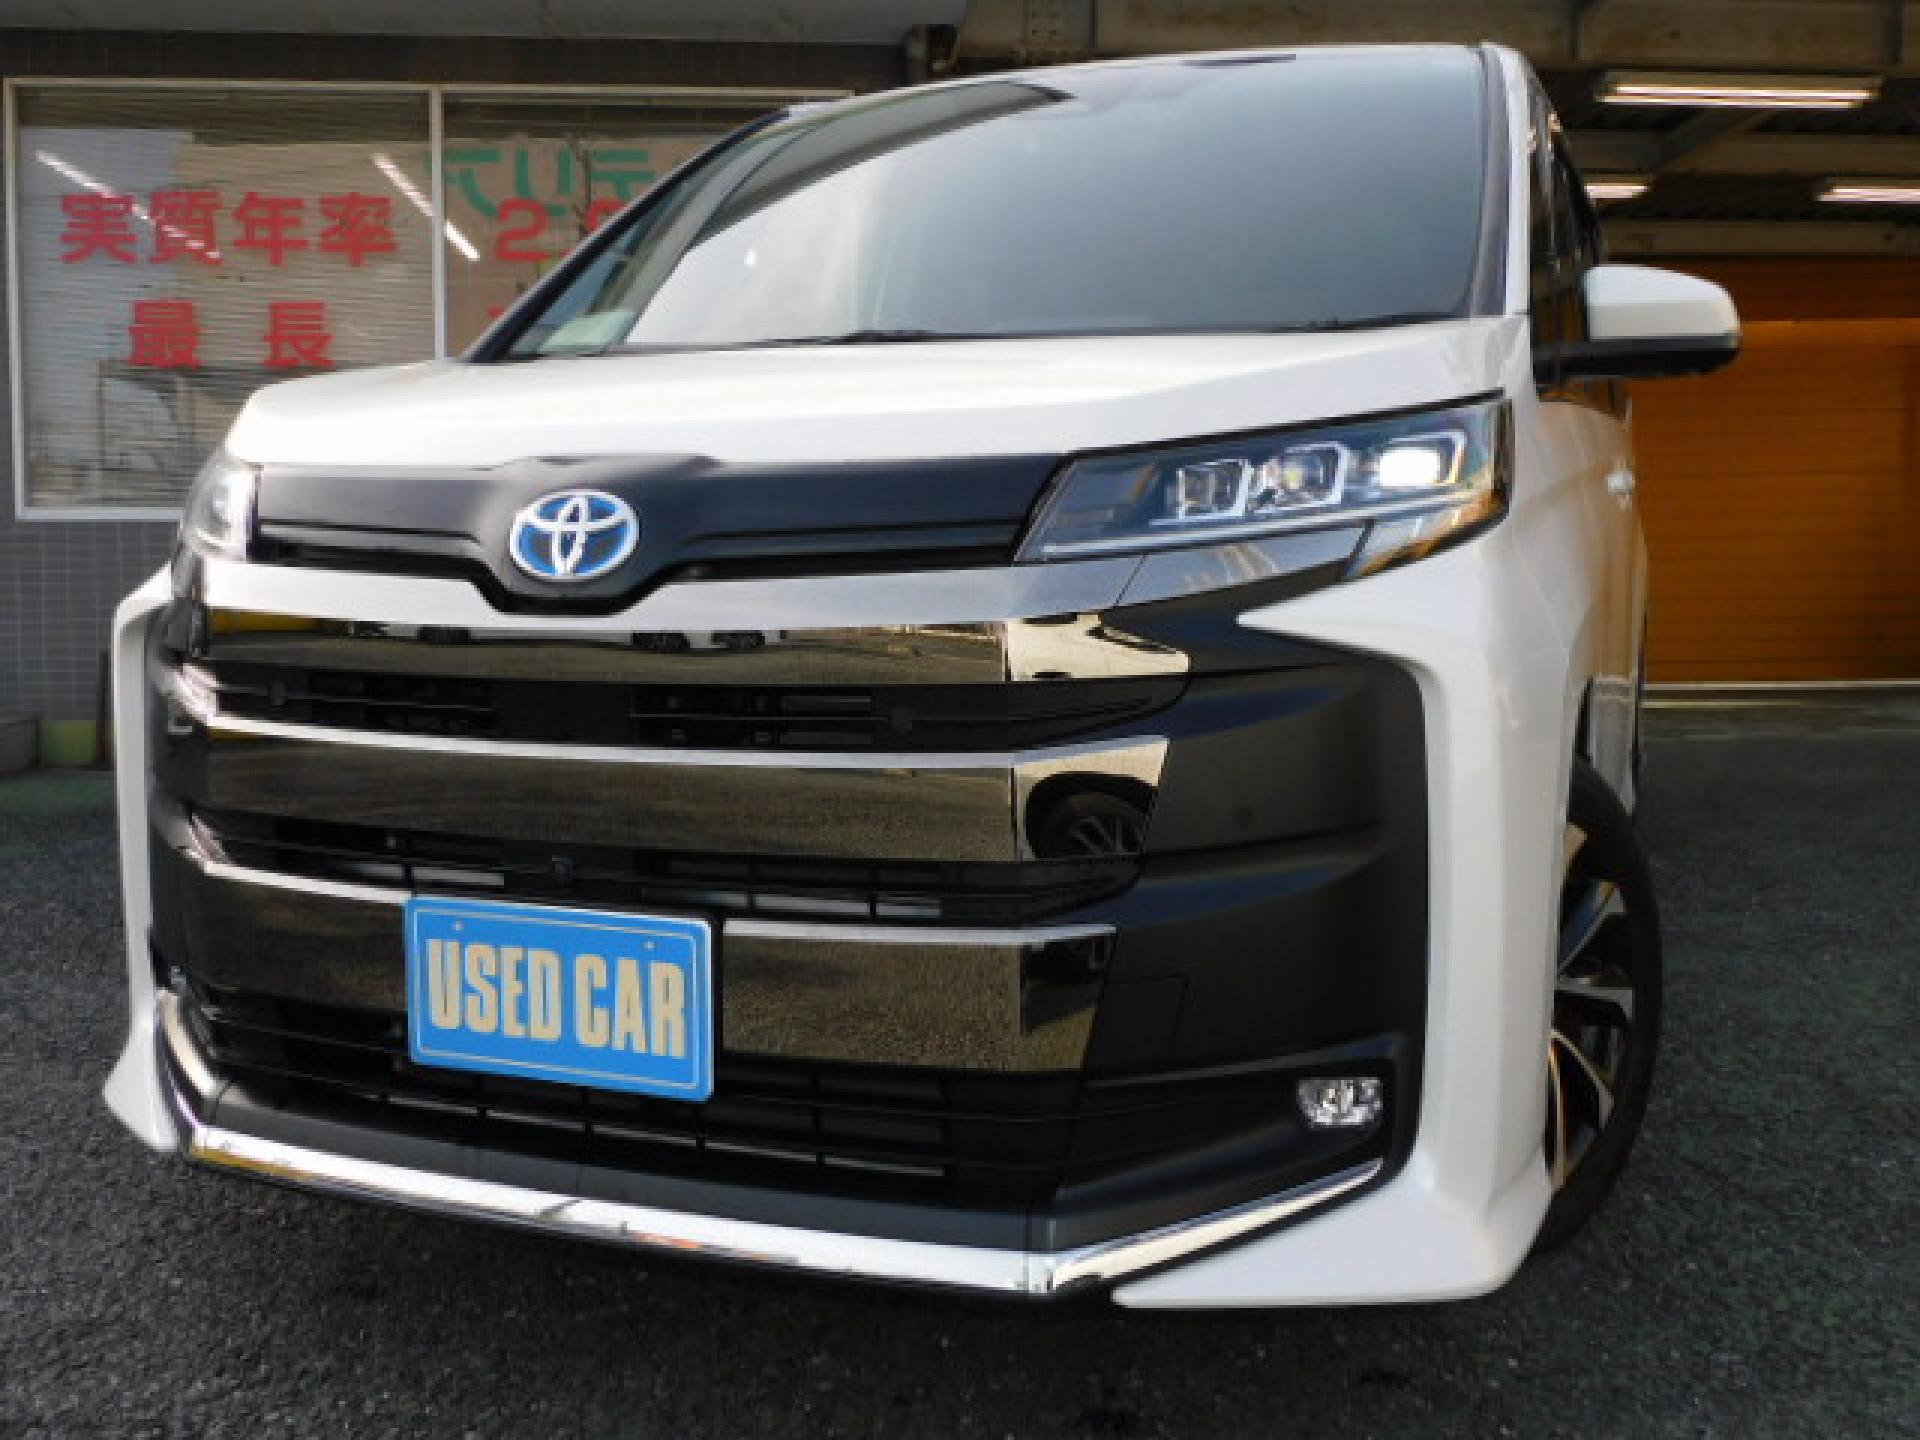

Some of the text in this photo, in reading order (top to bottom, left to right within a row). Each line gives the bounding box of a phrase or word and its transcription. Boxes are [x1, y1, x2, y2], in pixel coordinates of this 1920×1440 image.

[60, 191, 397, 267] 実質年率
[426, 938, 686, 1059] USED CAR
